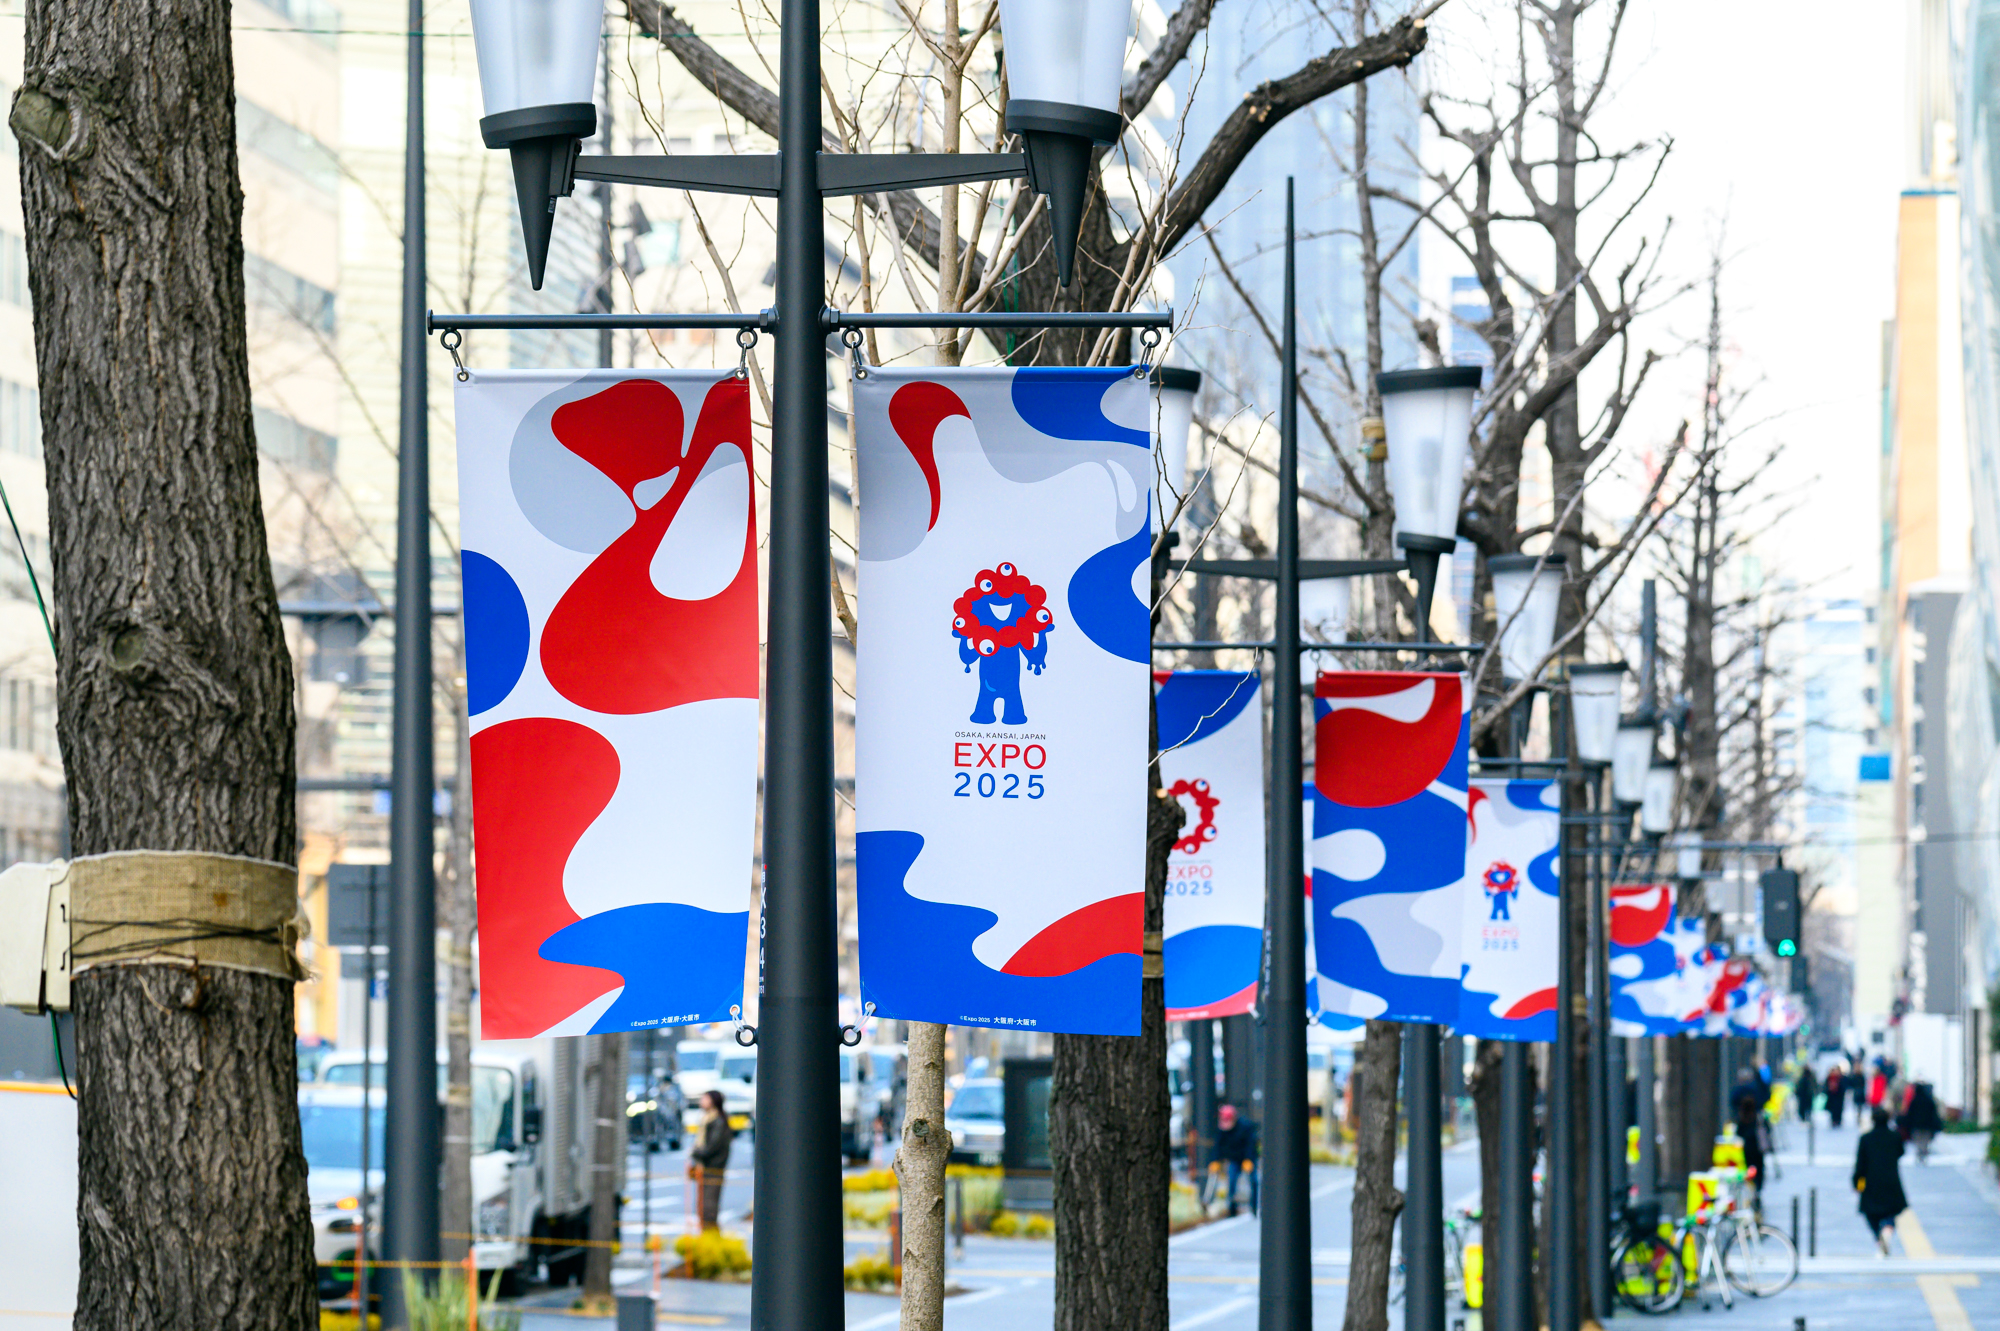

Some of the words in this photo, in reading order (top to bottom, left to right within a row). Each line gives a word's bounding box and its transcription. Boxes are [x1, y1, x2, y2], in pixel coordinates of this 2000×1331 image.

[955, 731, 985, 739] OSAKA,
[986, 732, 1018, 740] KANSAI,
[954, 742, 1047, 770] EXPO
[953, 772, 1045, 800] 2025
[1164, 880, 1213, 897] 2025
[1482, 926, 1519, 939] EXPO
[1482, 939, 1519, 951] 2025
